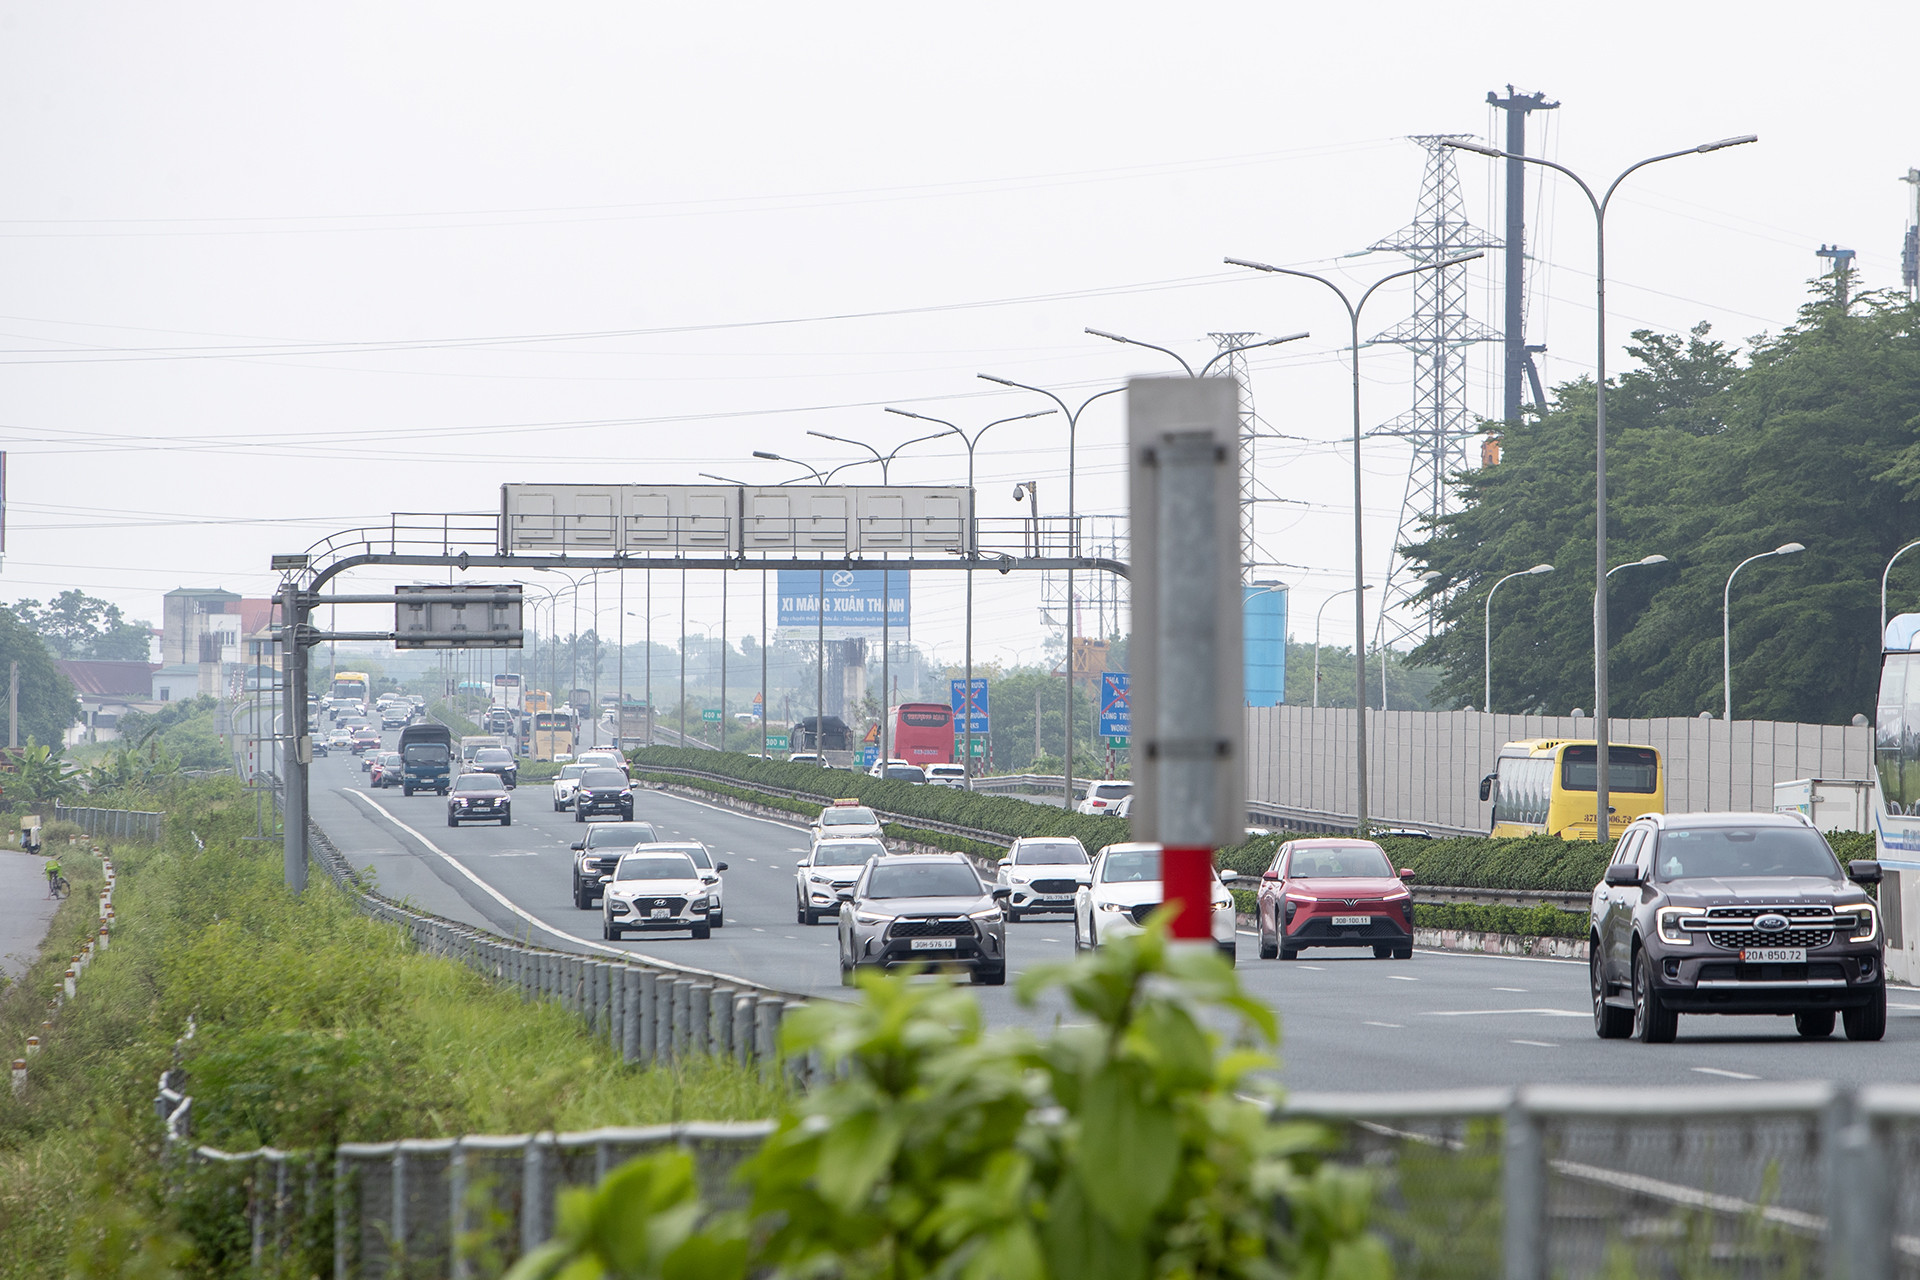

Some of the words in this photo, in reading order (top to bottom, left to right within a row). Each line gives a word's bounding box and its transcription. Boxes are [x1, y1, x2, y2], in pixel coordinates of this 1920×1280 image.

[782, 598, 793, 611] XI
[796, 594, 830, 612] MĂNG
[833, 595, 864, 612] XUÂN
[970, 680, 985, 689] RƯỚC
[766, 738, 777, 746] 300
